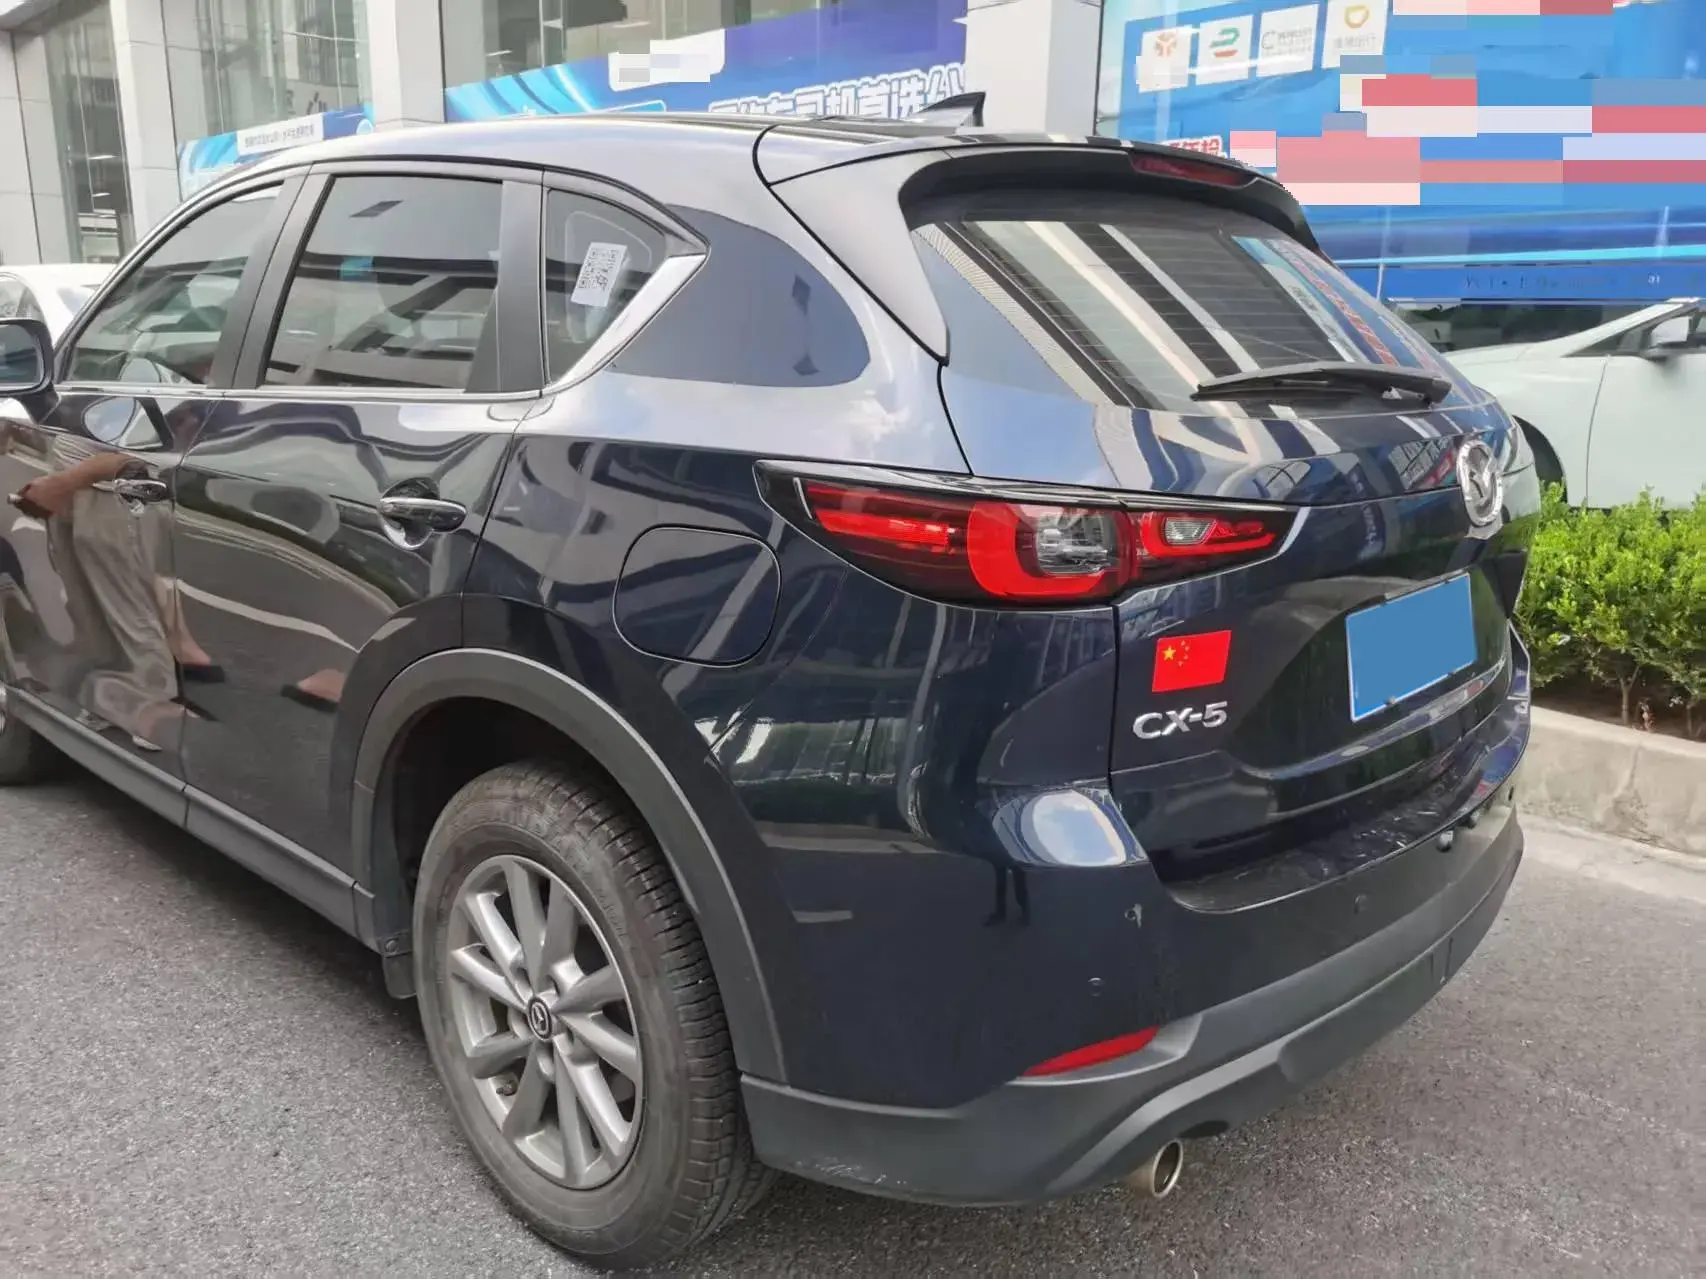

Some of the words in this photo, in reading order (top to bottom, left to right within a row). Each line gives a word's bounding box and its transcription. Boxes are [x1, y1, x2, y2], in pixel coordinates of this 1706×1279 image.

[709, 65, 965, 118] 司机首选公
[1132, 701, 1228, 739] CX-5
